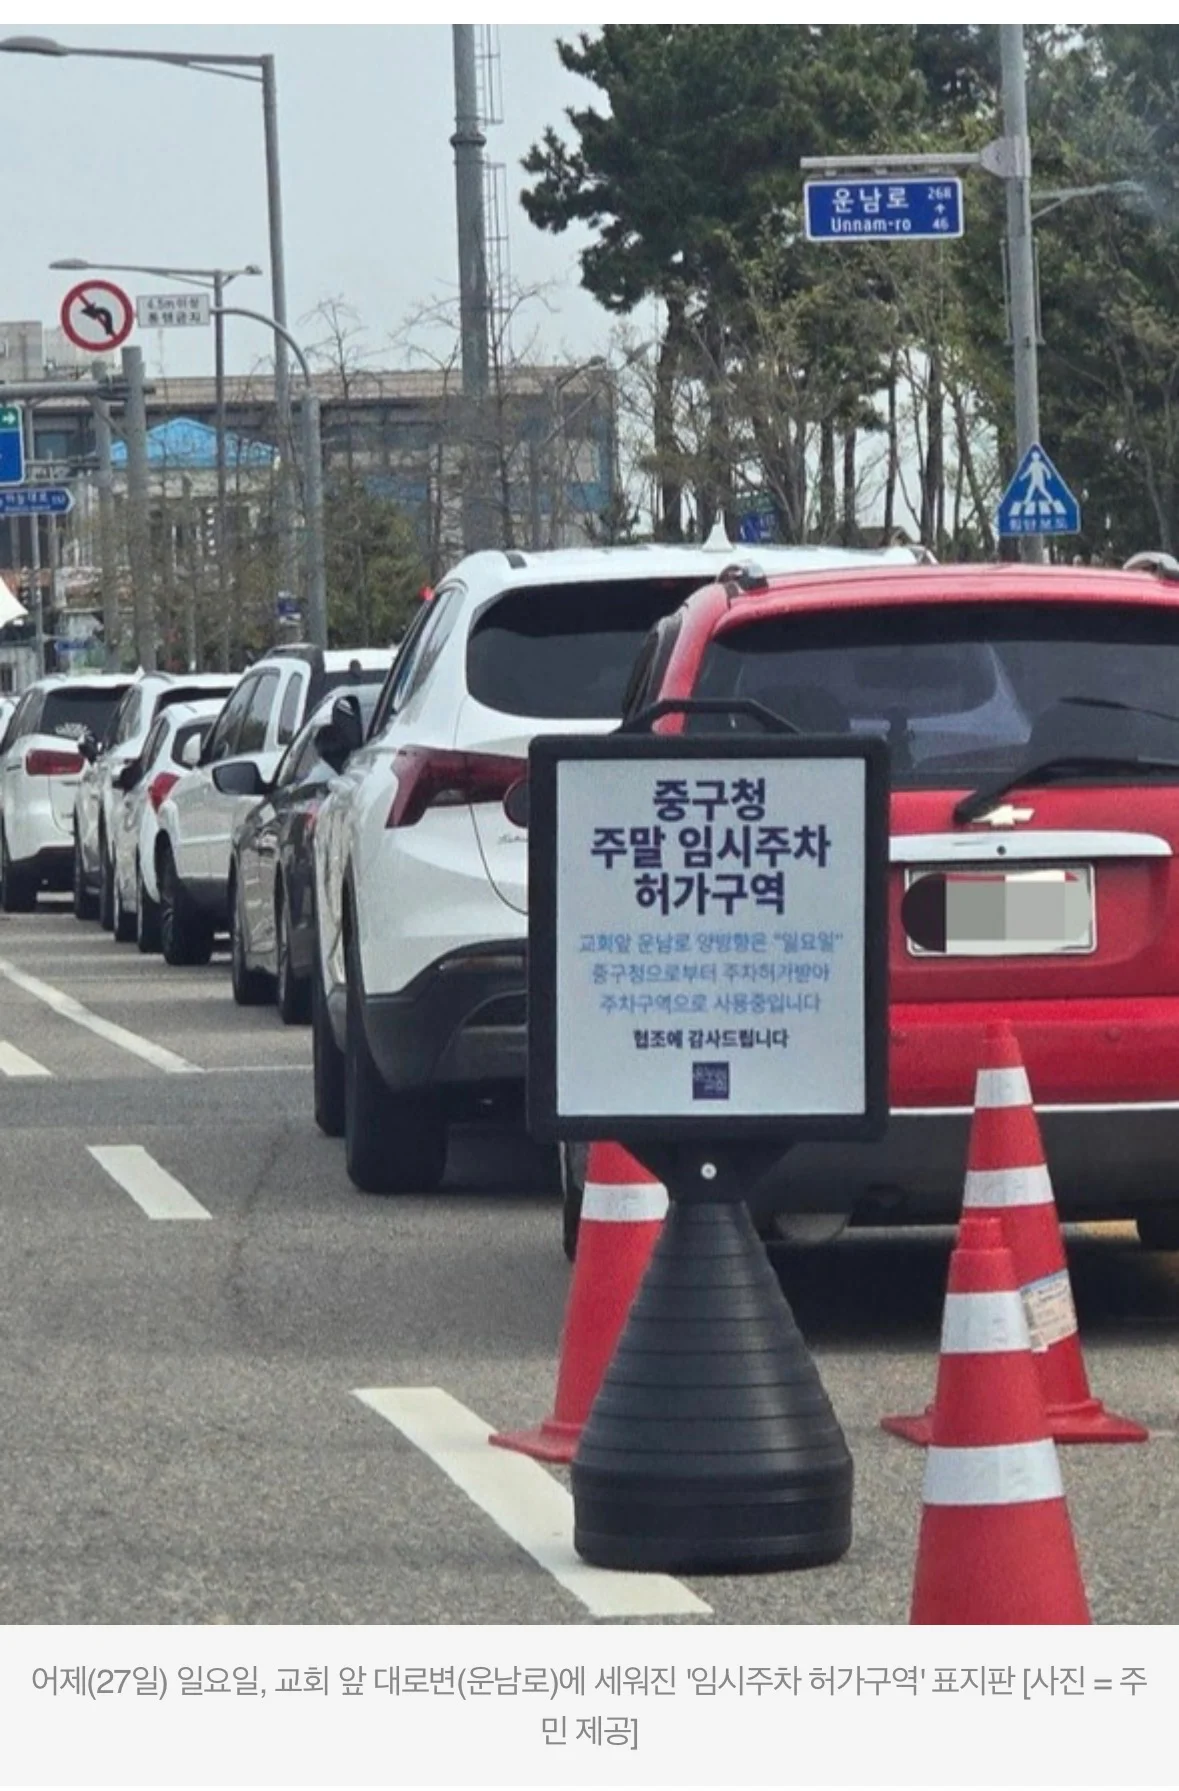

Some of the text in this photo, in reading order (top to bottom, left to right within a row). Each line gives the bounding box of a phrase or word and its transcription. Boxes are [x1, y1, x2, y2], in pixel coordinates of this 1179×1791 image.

[832, 187, 909, 213] 운남로
[928, 187, 952, 200] 268
[830, 216, 912, 233] Unnam-ro
[932, 216, 949, 231] 46
[653, 778, 766, 822] 중구청
[591, 824, 831, 869] 주말 임시주차
[634, 871, 785, 916] 허가구역
[579, 933, 632, 955] 교회앞
[638, 933, 691, 955] 운남로
[696, 932, 767, 954] 양방향은
[592, 962, 830, 985] 중구청으로부터 주차허가받아
[600, 992, 821, 1015] 주차구역으로 사용중입니다
[633, 1029, 789, 1050] 협조에 감사드립니다
